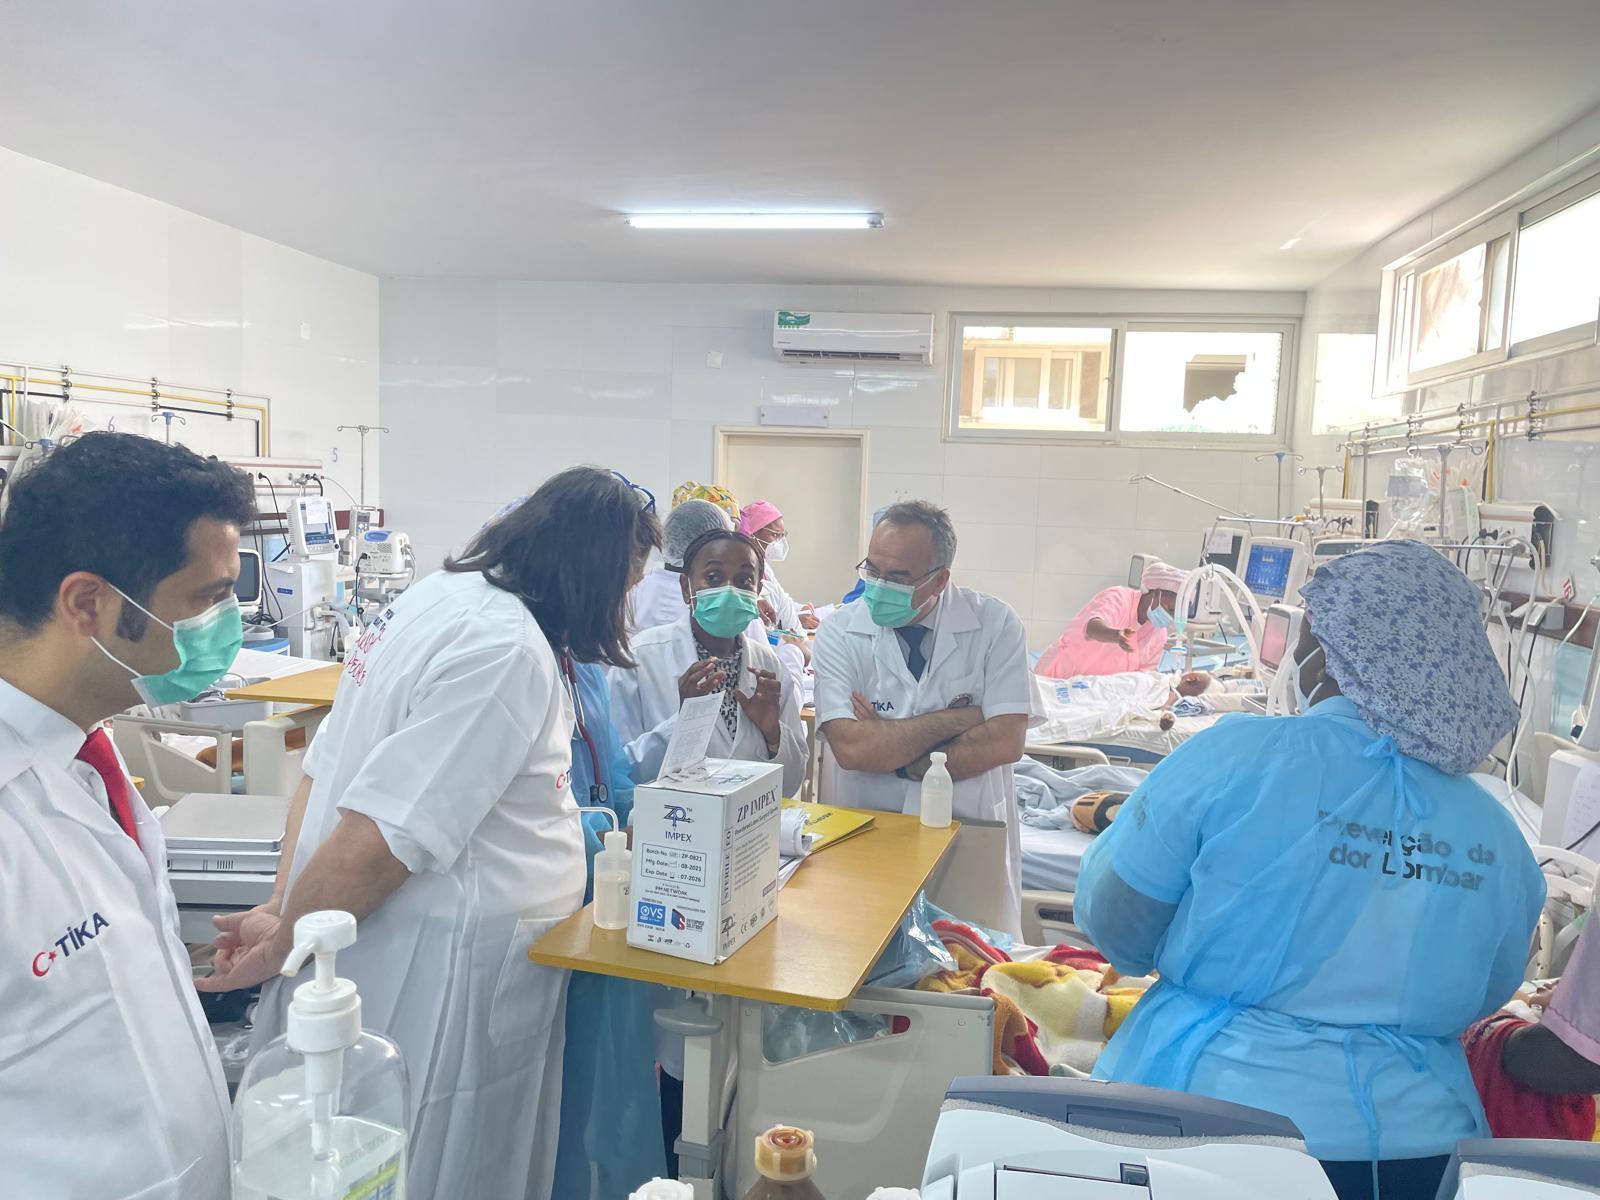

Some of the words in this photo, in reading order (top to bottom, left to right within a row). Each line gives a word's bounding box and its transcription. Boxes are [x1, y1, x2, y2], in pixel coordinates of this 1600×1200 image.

[737, 804, 749, 823] ZP
[750, 789, 776, 816] IMPEX
[665, 830, 692, 843] IMPEX
[1328, 842, 1372, 869] dor
[663, 887, 688, 896] NETWORK
